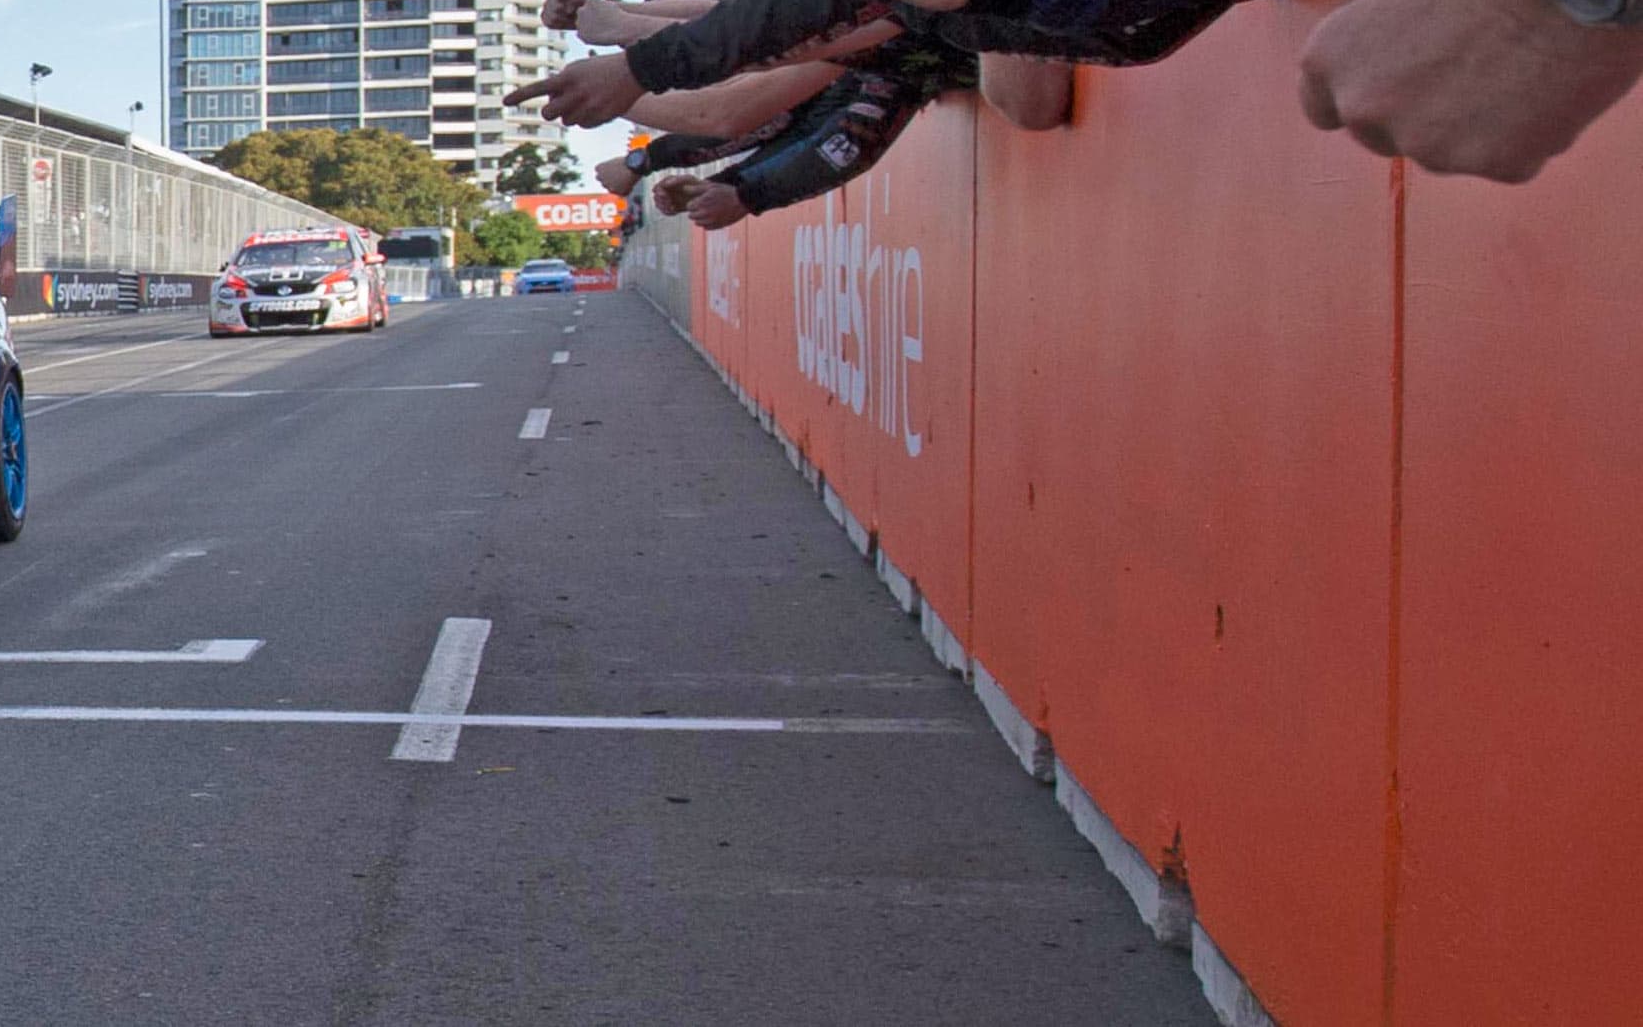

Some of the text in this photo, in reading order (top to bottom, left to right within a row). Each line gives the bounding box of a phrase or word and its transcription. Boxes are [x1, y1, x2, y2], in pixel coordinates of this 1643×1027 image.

[535, 198, 618, 227] coate
[57, 274, 119, 310] sydney.com
[149, 276, 193, 305] sydney.com
